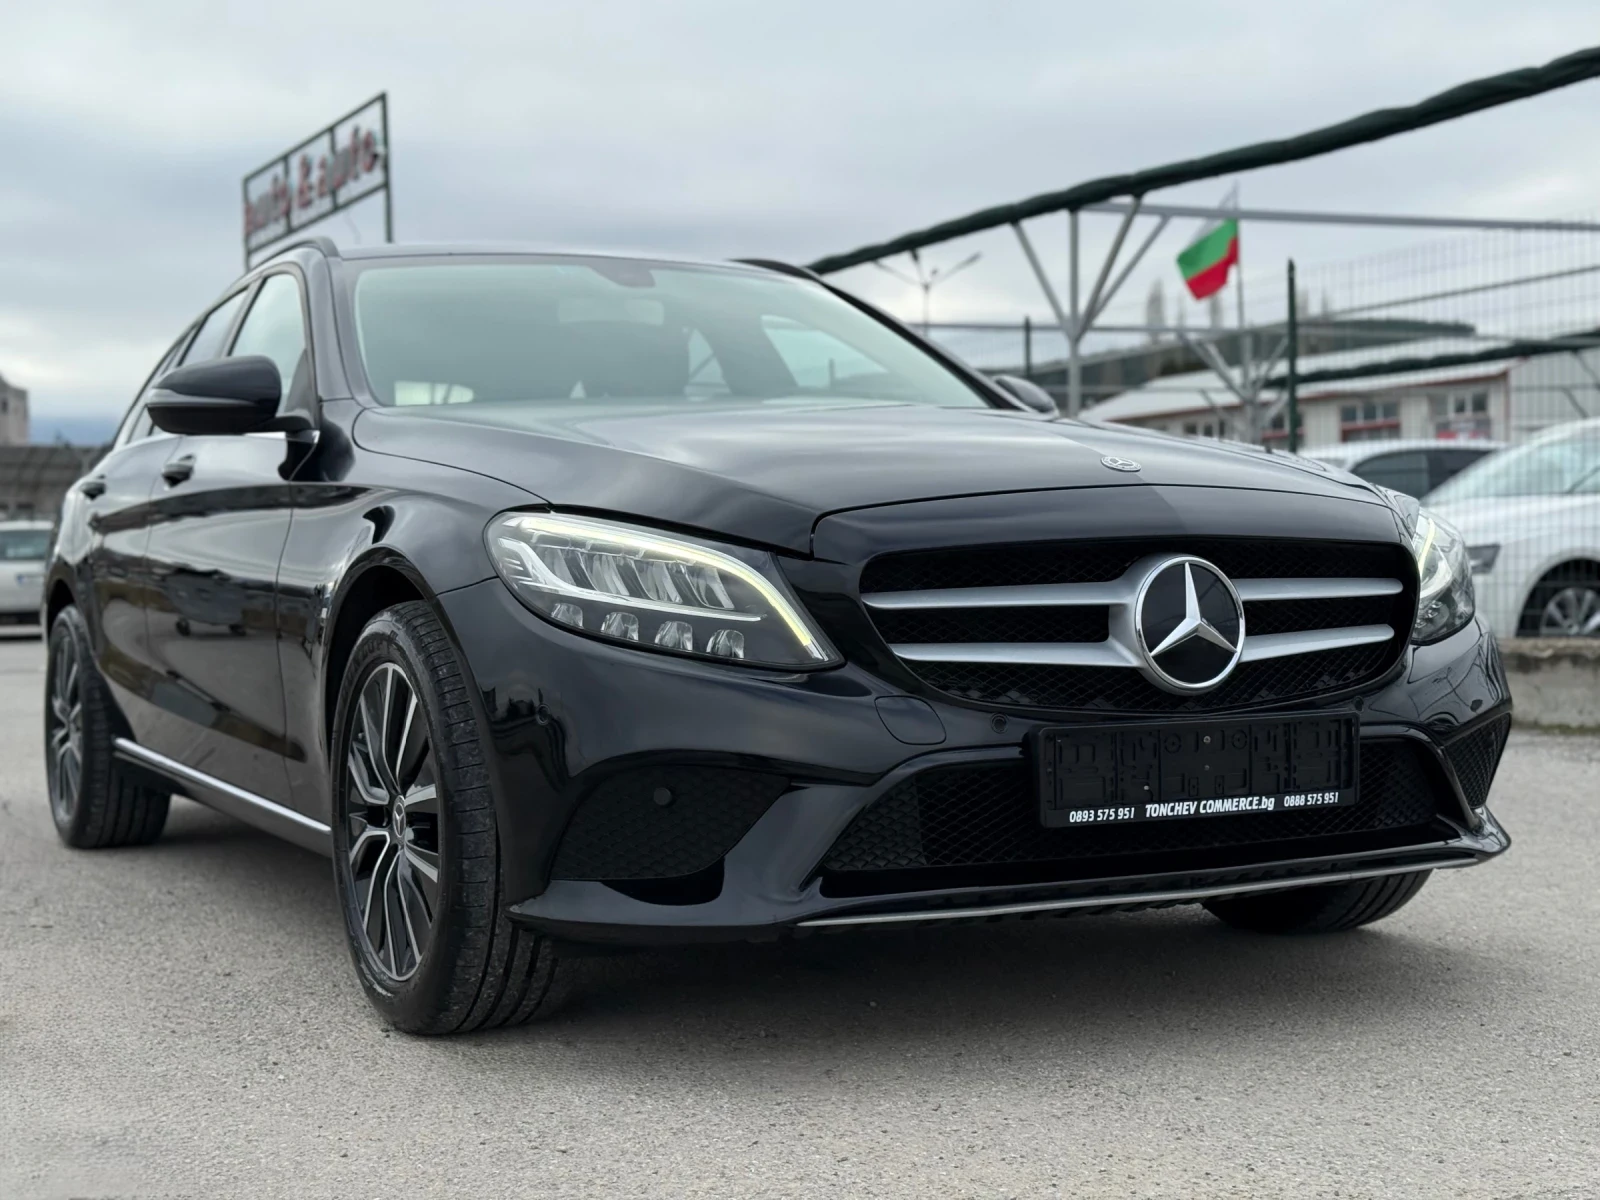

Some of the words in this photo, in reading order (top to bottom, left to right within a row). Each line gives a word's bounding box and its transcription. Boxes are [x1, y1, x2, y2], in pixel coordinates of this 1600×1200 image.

[1069, 809, 1095, 824] 0893
[1096, 807, 1116, 822] 575
[1117, 806, 1135, 820] 951
[1145, 800, 1198, 818] TONCHEV
[1199, 796, 1275, 814] COMMERCE.bg
[1284, 794, 1306, 808] 0888
[1306, 793, 1323, 806] 575
[1323, 791, 1339, 804] 951
